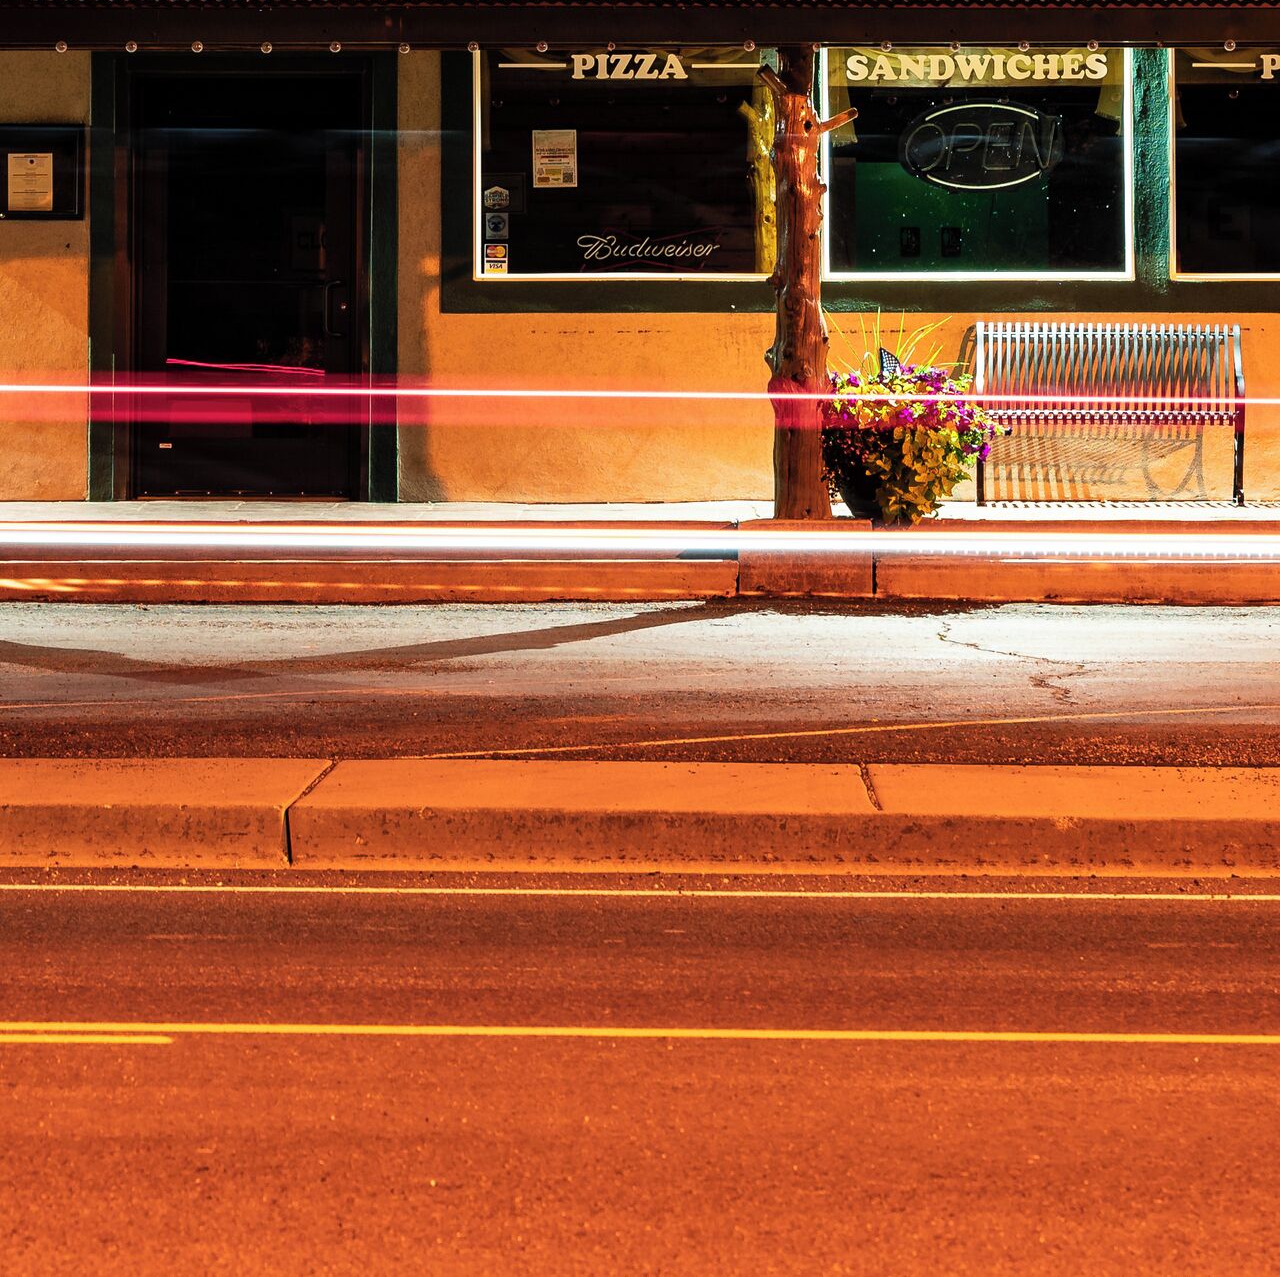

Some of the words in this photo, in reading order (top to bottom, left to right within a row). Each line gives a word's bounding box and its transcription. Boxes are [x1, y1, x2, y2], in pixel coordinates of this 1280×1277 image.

[570, 53, 689, 80] PIZZA
[846, 52, 1108, 81] SANDWICHES
[905, 115, 1057, 172] OPEN
[576, 235, 721, 260] Budweiser
